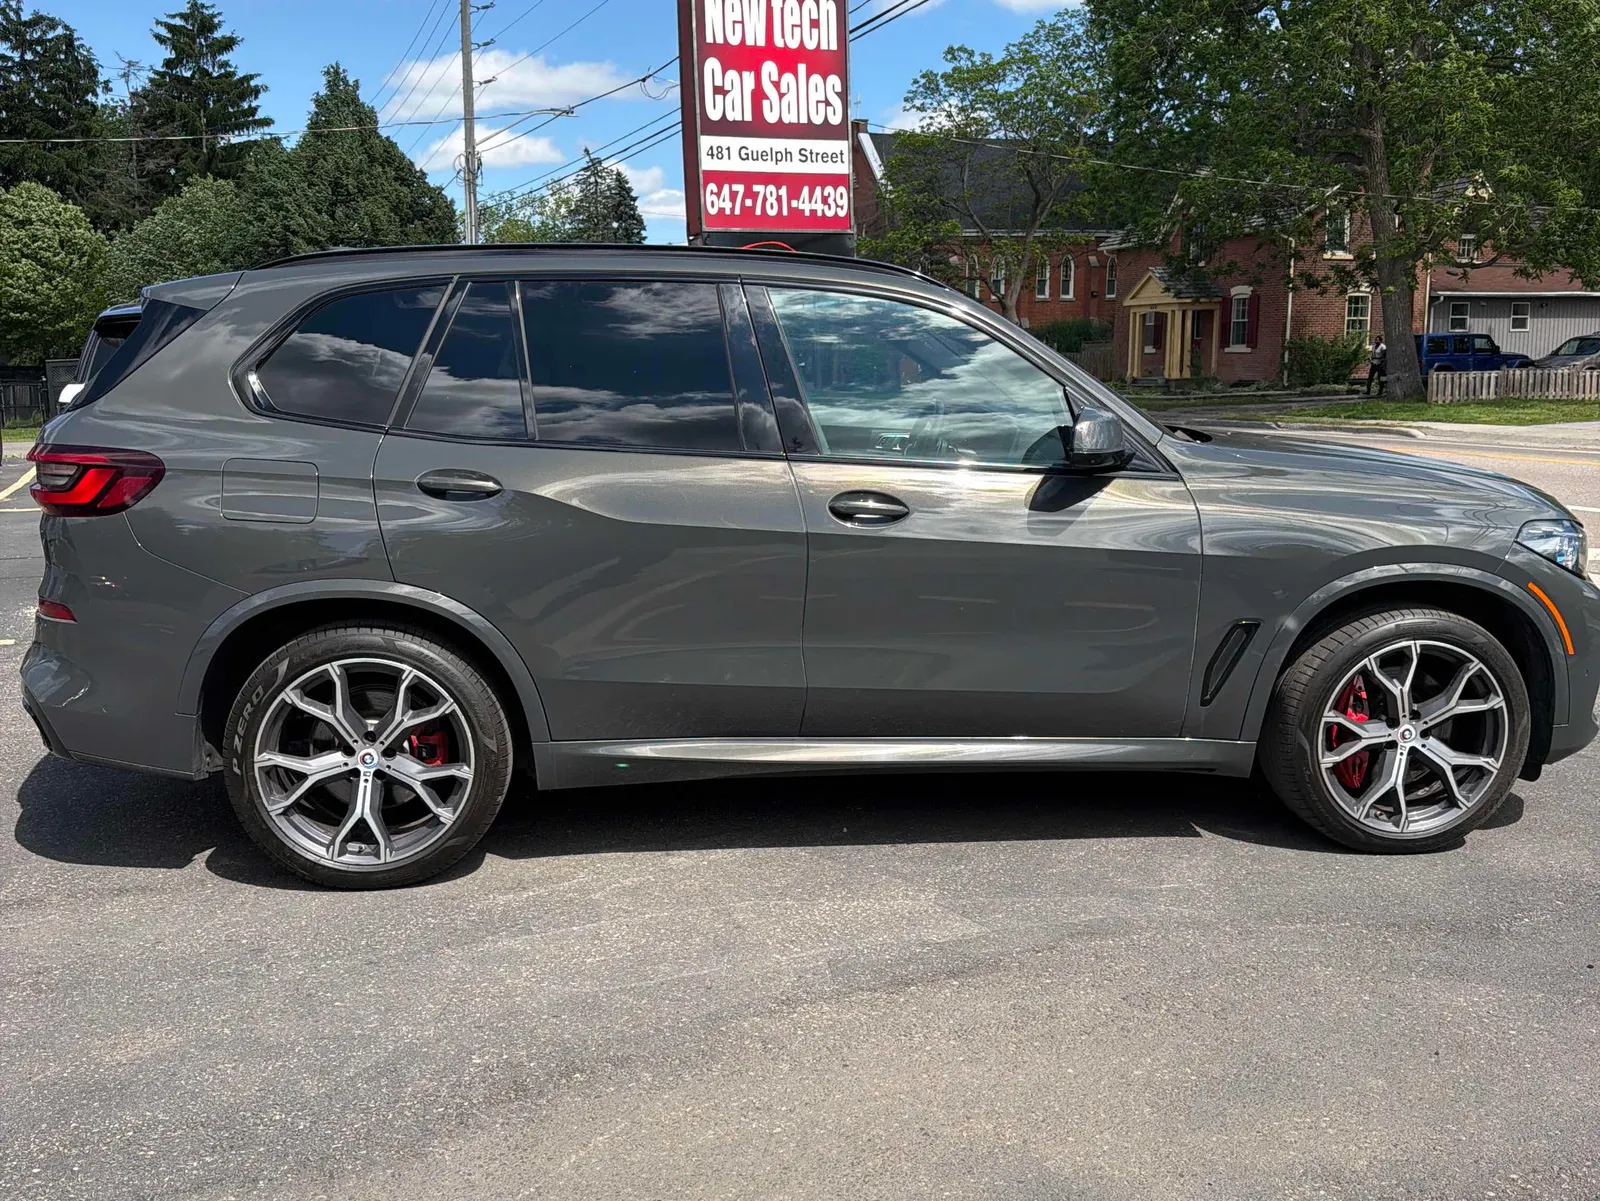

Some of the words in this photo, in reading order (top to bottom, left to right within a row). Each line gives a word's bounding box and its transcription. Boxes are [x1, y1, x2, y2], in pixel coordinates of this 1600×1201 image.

[703, 57, 755, 121] Car
[761, 60, 843, 125] Sales
[706, 146, 732, 161] 481
[738, 146, 793, 165] Guelph
[798, 148, 845, 164] Street
[705, 182, 848, 218] 647-781-4439
[233, 684, 264, 754] ZERO
[232, 757, 241, 775] P
